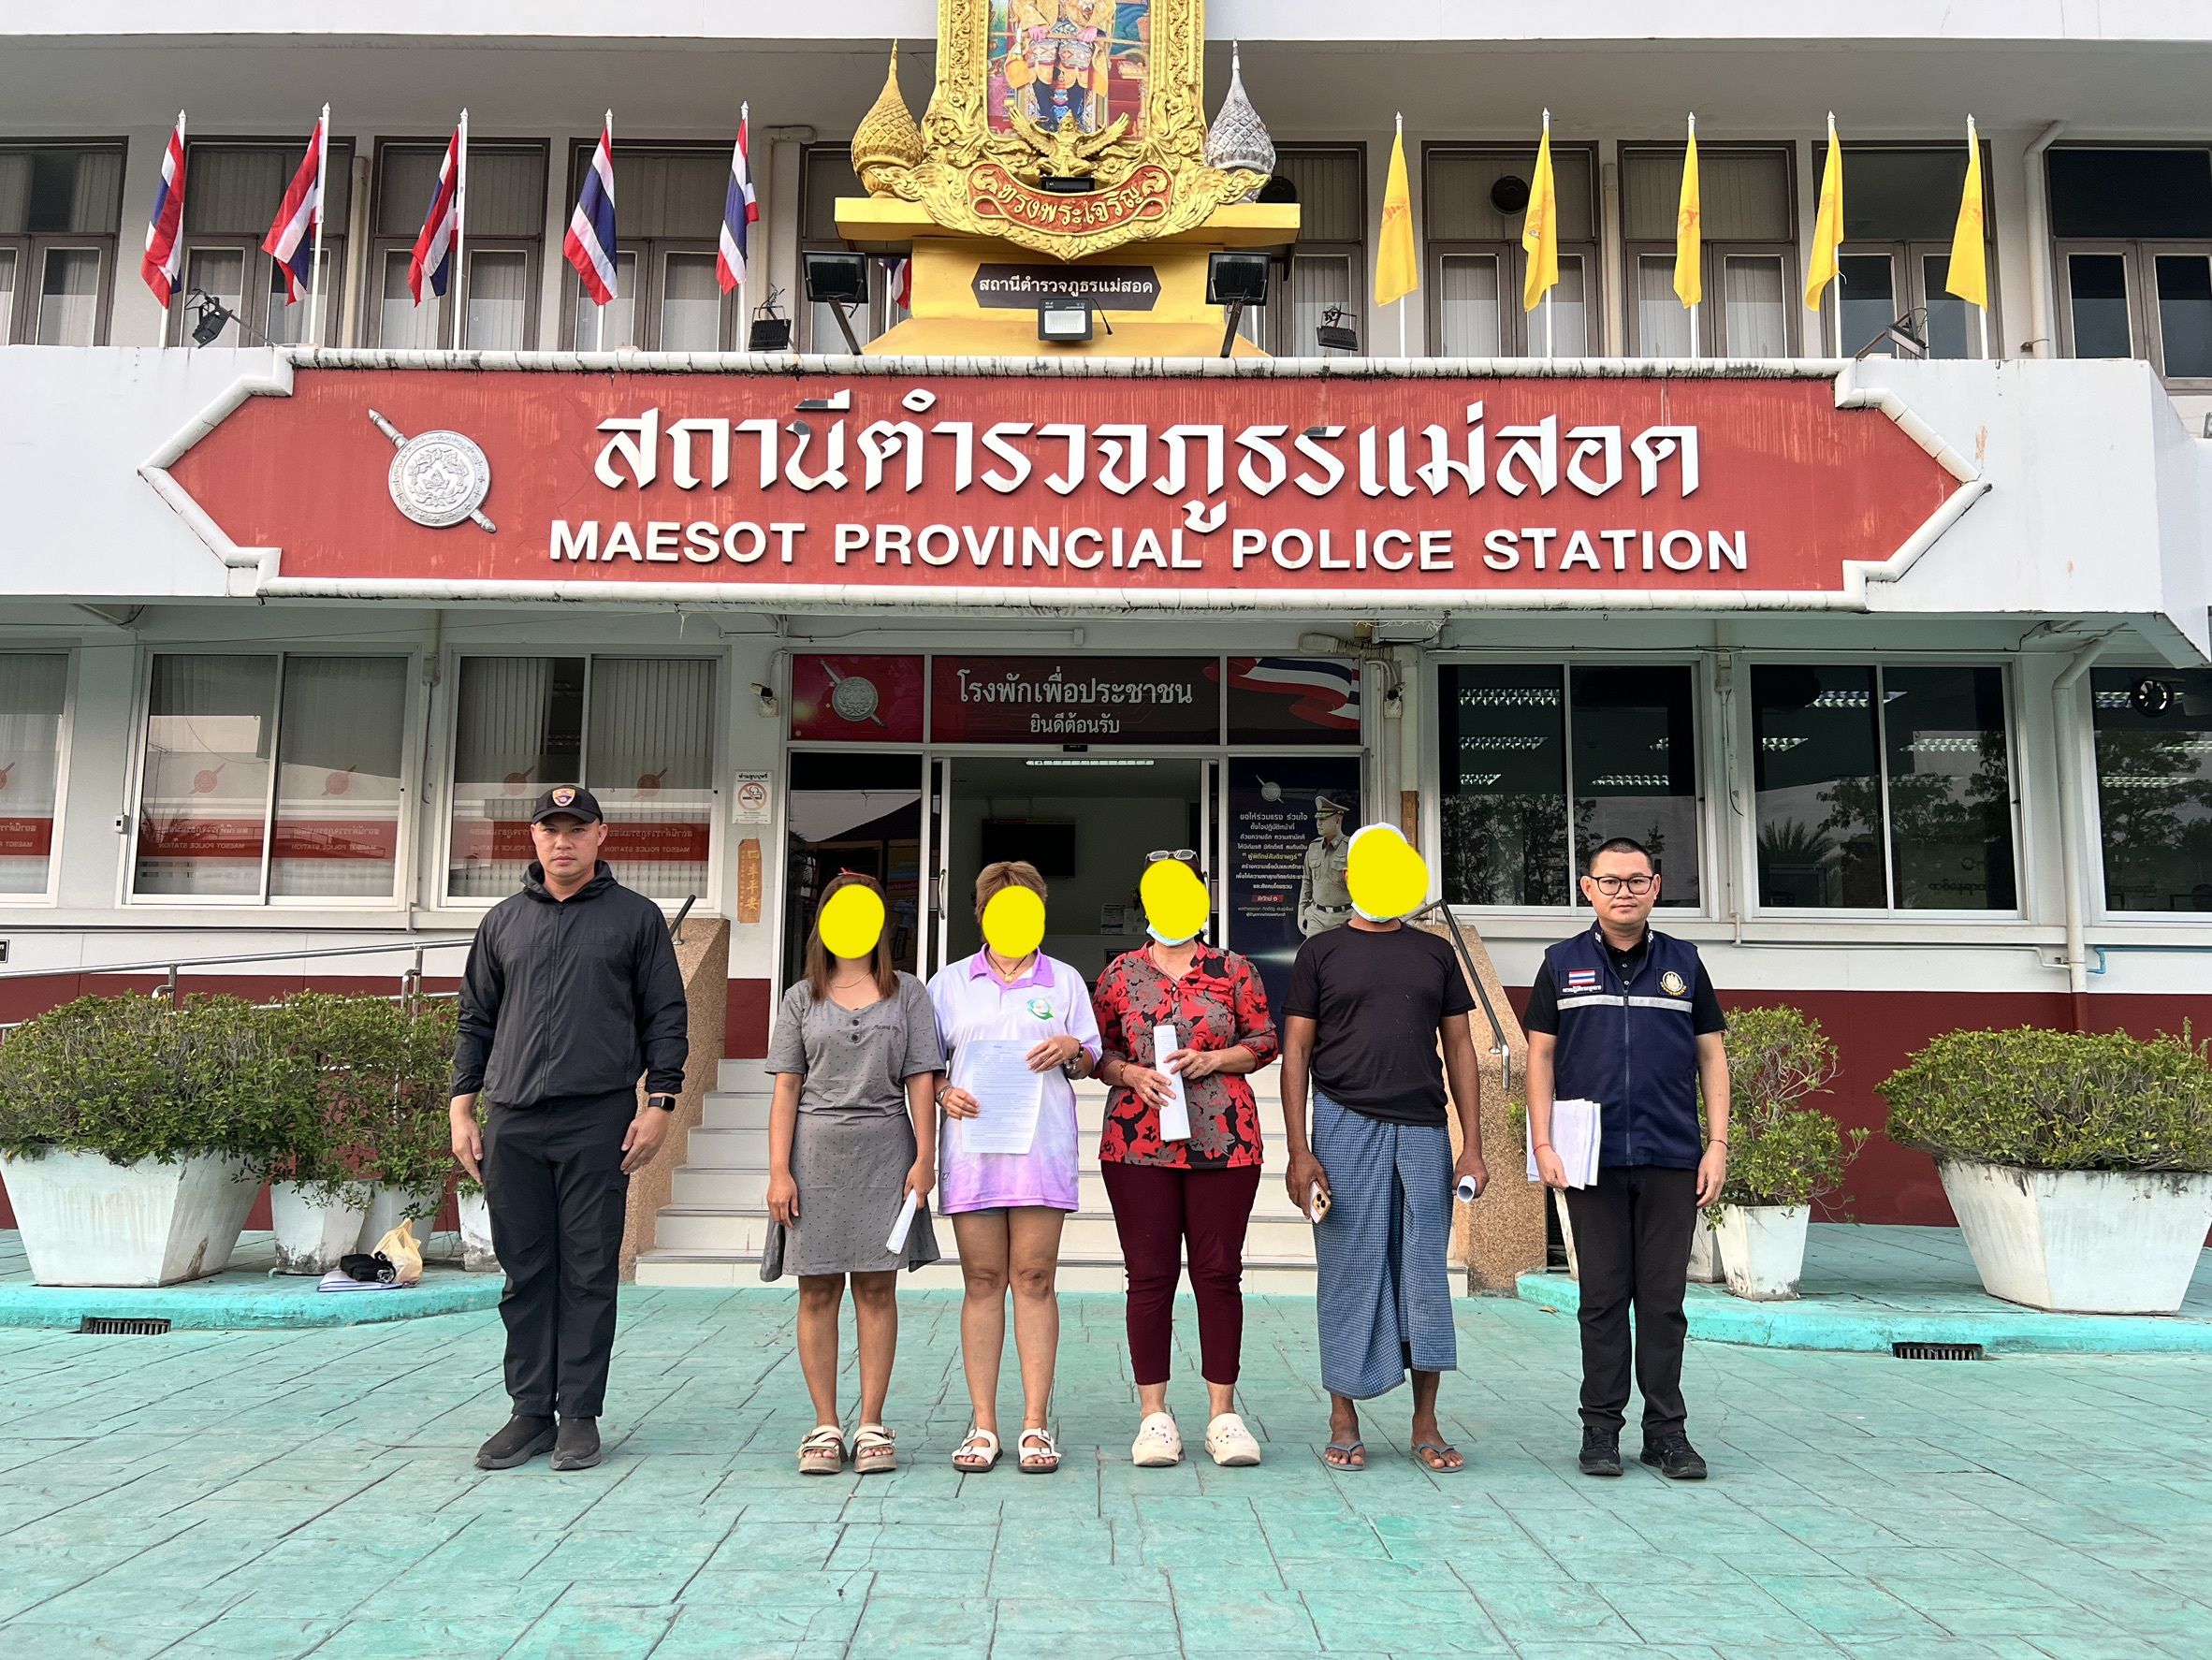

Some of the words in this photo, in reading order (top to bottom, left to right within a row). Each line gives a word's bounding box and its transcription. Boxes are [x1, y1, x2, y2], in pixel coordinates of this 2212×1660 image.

[997, 182, 1144, 226] ทรงพระเจริญ
[979, 274, 1153, 298] สถานีตำรวจภูธรแม่สอด
[593, 387, 1699, 533] สถานีตำรวจภูธรแม่สอด
[549, 519, 806, 563] MAESOT
[835, 523, 1202, 569] PROVINCIAL
[1232, 528, 1455, 570] POLICE
[1483, 527, 1748, 571] STATION
[956, 665, 1193, 703] โรงพักเพื่อประชาชน
[1030, 712, 1119, 734] ยินดีต้อนรับ
[1286, 811, 1308, 821] ร่วมใจ
